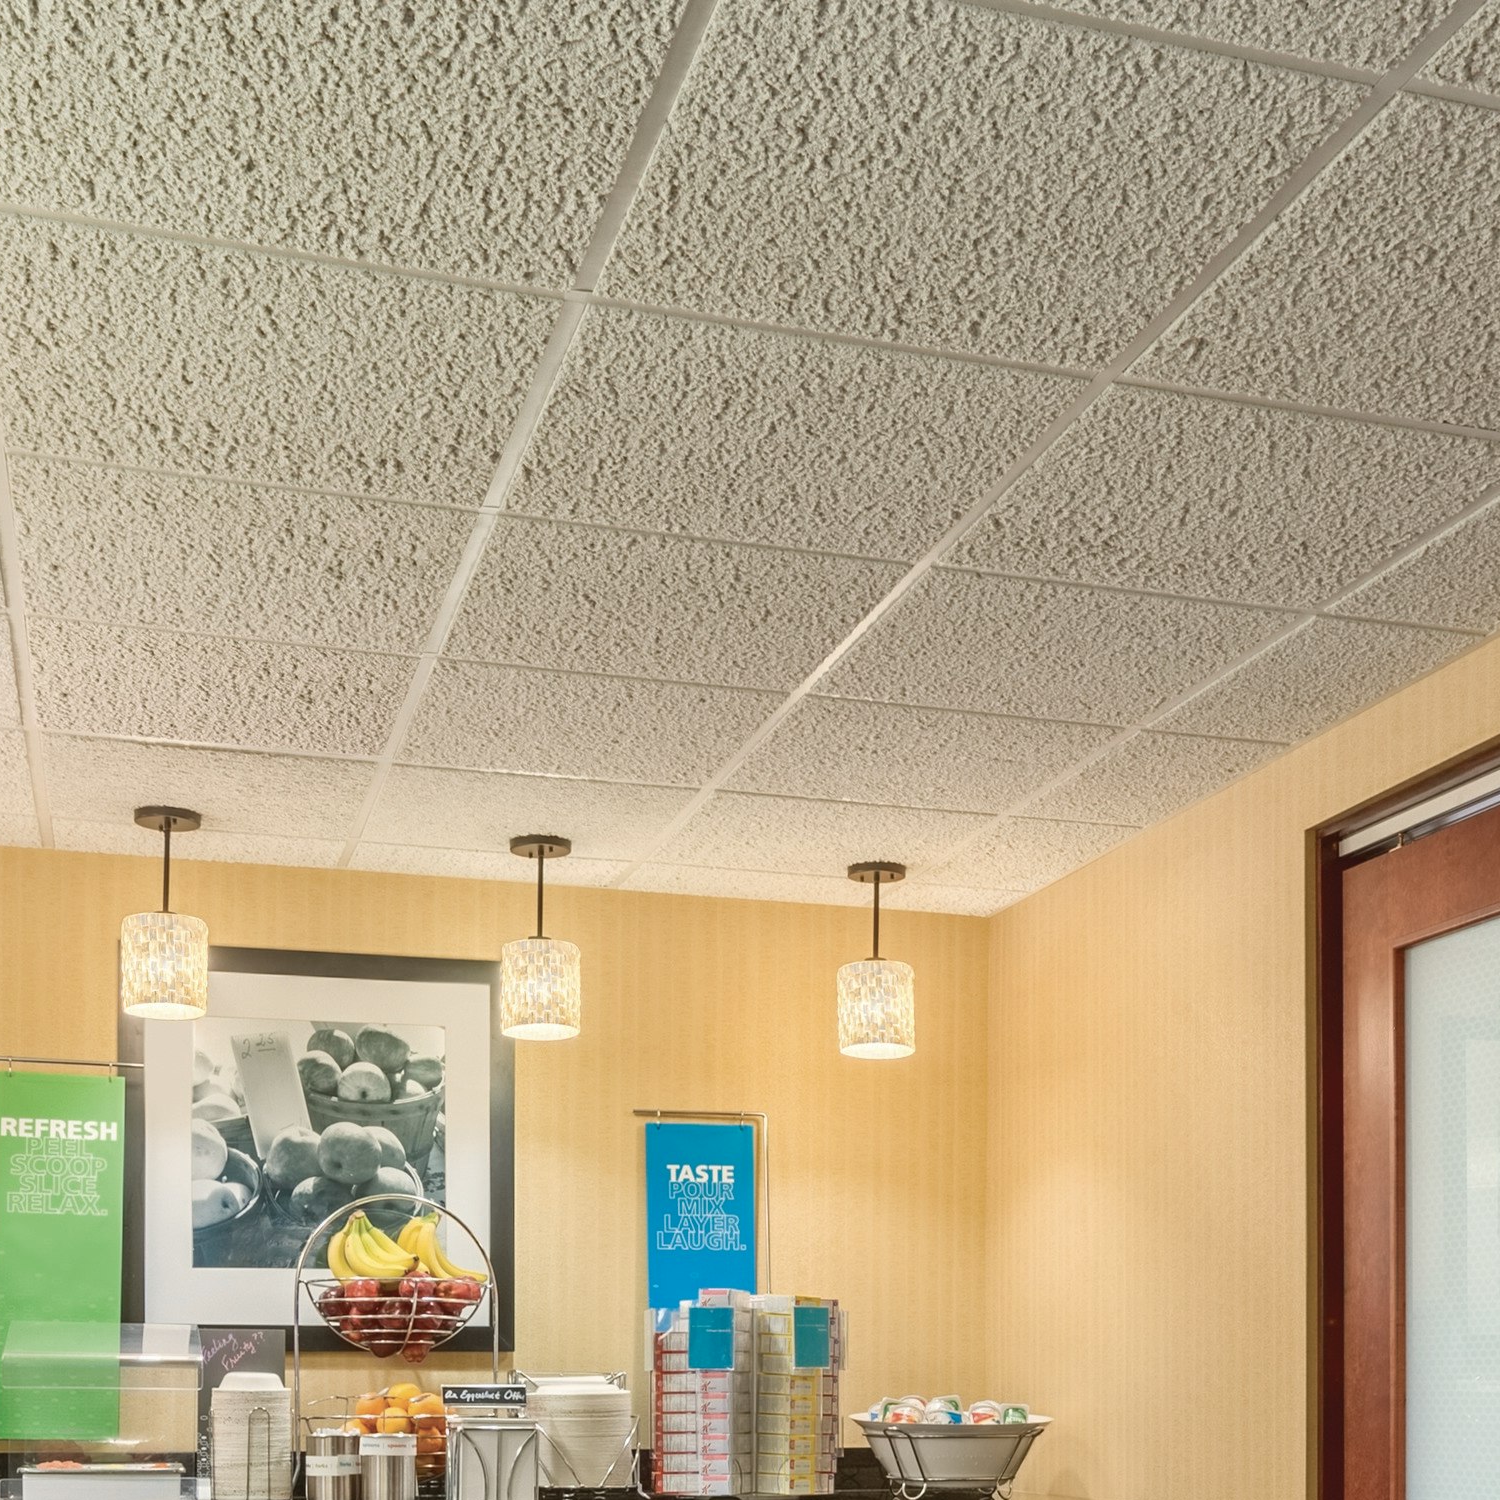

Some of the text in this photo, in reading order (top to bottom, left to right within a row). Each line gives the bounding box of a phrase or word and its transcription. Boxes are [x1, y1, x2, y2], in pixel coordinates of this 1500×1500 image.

[0, 1117, 118, 1141] REFRESH
[26, 1136, 93, 1157] PEEL
[10, 1154, 107, 1177] SCOOP
[666, 1164, 735, 1183] TASTE
[19, 1174, 97, 1196] SLICE
[668, 1180, 734, 1200] POUR
[7, 1192, 108, 1216] RELAX.
[678, 1197, 726, 1216] MIX
[663, 1214, 740, 1233] LAYER
[657, 1231, 747, 1251] LAUGH.
